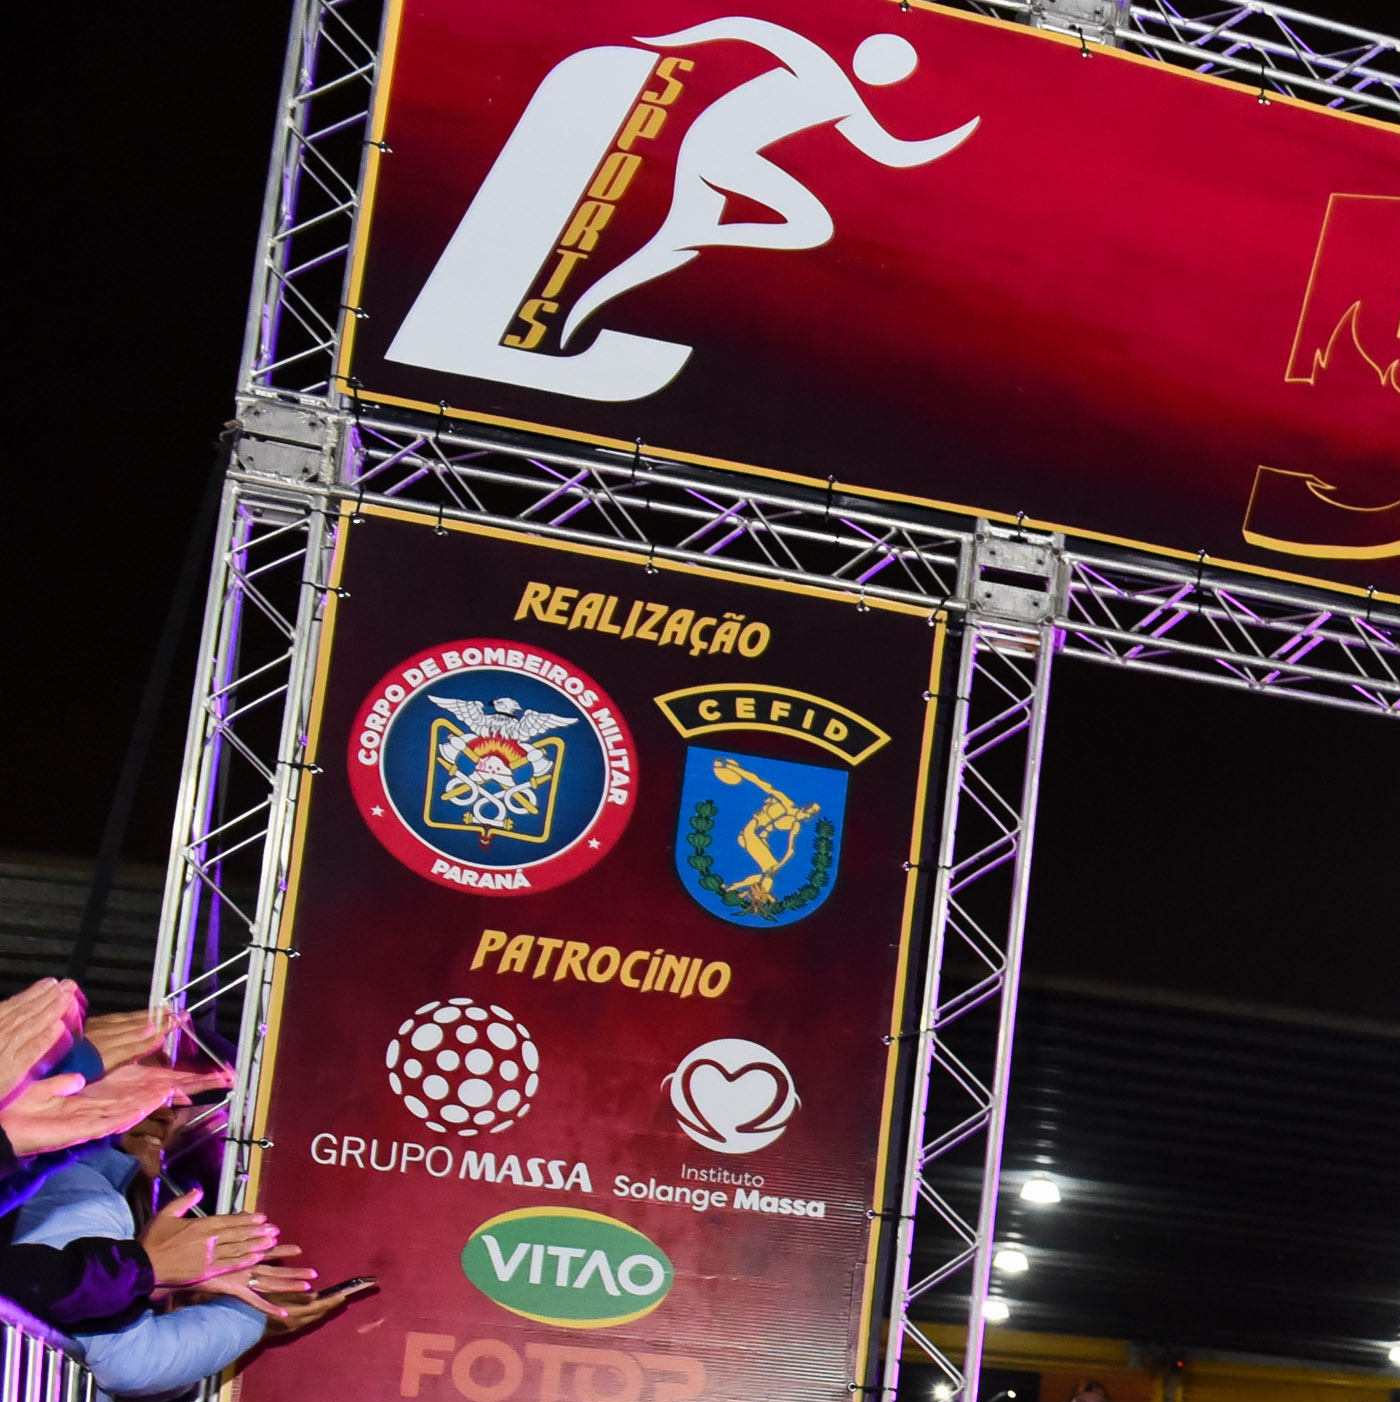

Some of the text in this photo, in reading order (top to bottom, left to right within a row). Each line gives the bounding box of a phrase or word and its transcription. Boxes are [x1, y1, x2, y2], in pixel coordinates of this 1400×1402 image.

[503, 56, 696, 350] SPORTS
[513, 580, 771, 659] REALIZAÇÃO
[357, 646, 631, 806] CORPO DE BOMBEIROS MILITAR
[697, 697, 850, 743] CEFID
[430, 858, 531, 892] PARANÁ
[470, 929, 733, 1000] PATROCÍNIO
[310, 1132, 593, 1194] GRUPO MASSA
[680, 1162, 765, 1188] Instituto
[612, 1174, 826, 1220] Solange Massa
[480, 1233, 665, 1297] VITAO
